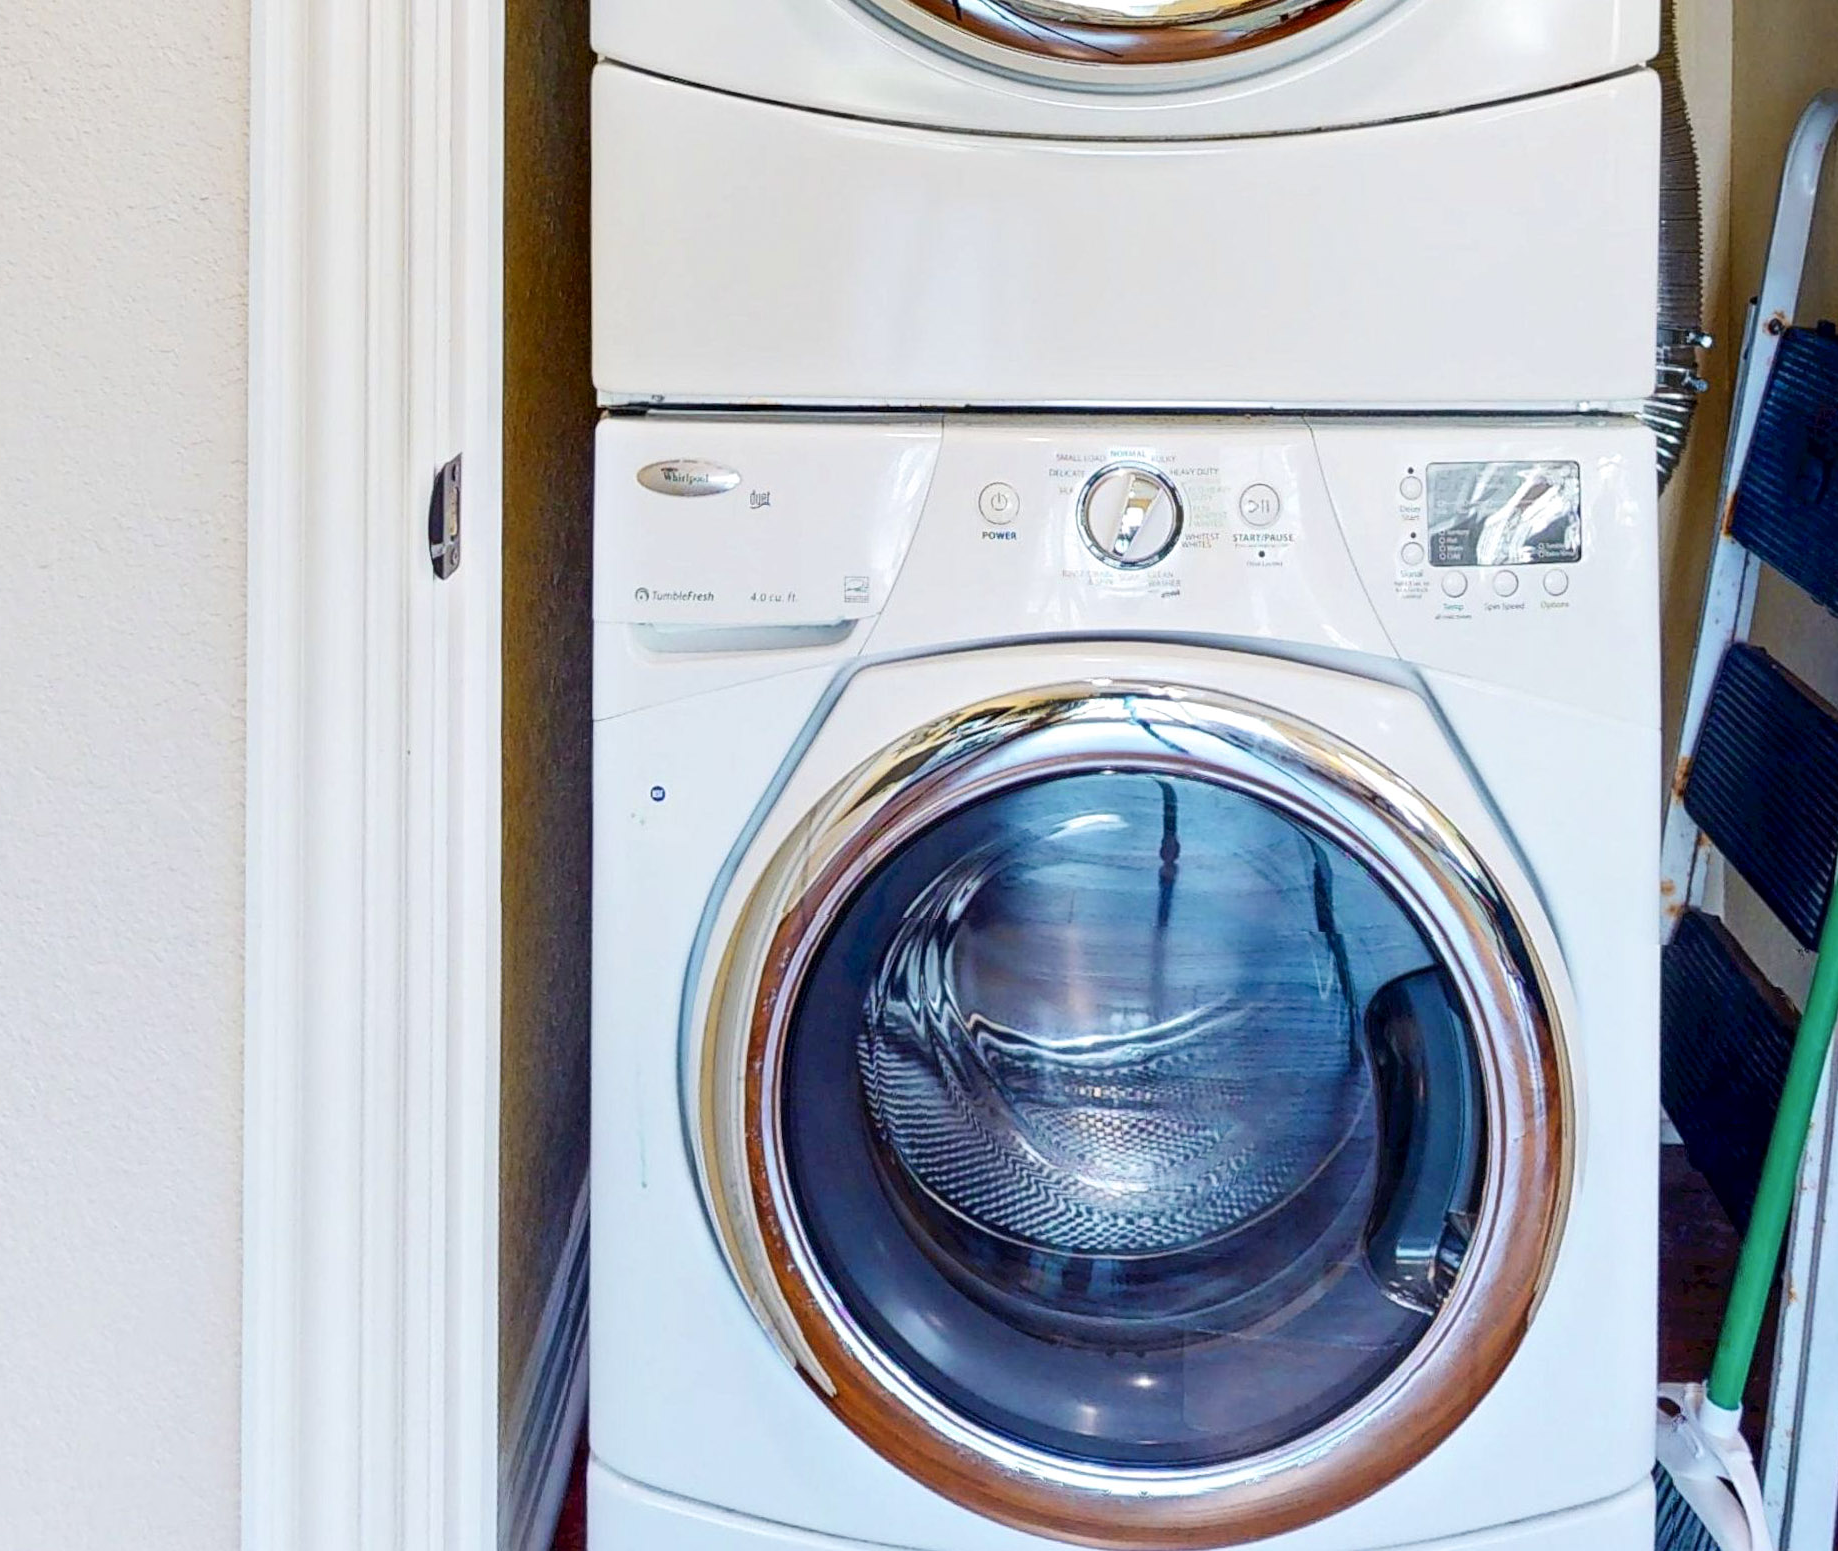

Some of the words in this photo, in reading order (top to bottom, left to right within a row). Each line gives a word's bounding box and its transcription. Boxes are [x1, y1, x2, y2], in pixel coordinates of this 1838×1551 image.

[1056, 454, 1083, 462] SMALL
[1110, 449, 1146, 459] NORMAL
[662, 468, 710, 485] Whirlpool
[1048, 468, 1086, 478] DELICATE
[1169, 467, 1196, 477] HEAVY
[1197, 467, 1220, 476] DUTY
[749, 489, 772, 507] duet
[981, 530, 1018, 541] POWER
[1232, 533, 1296, 543] START/PAUSE
[652, 589, 715, 603] TumbleFresh
